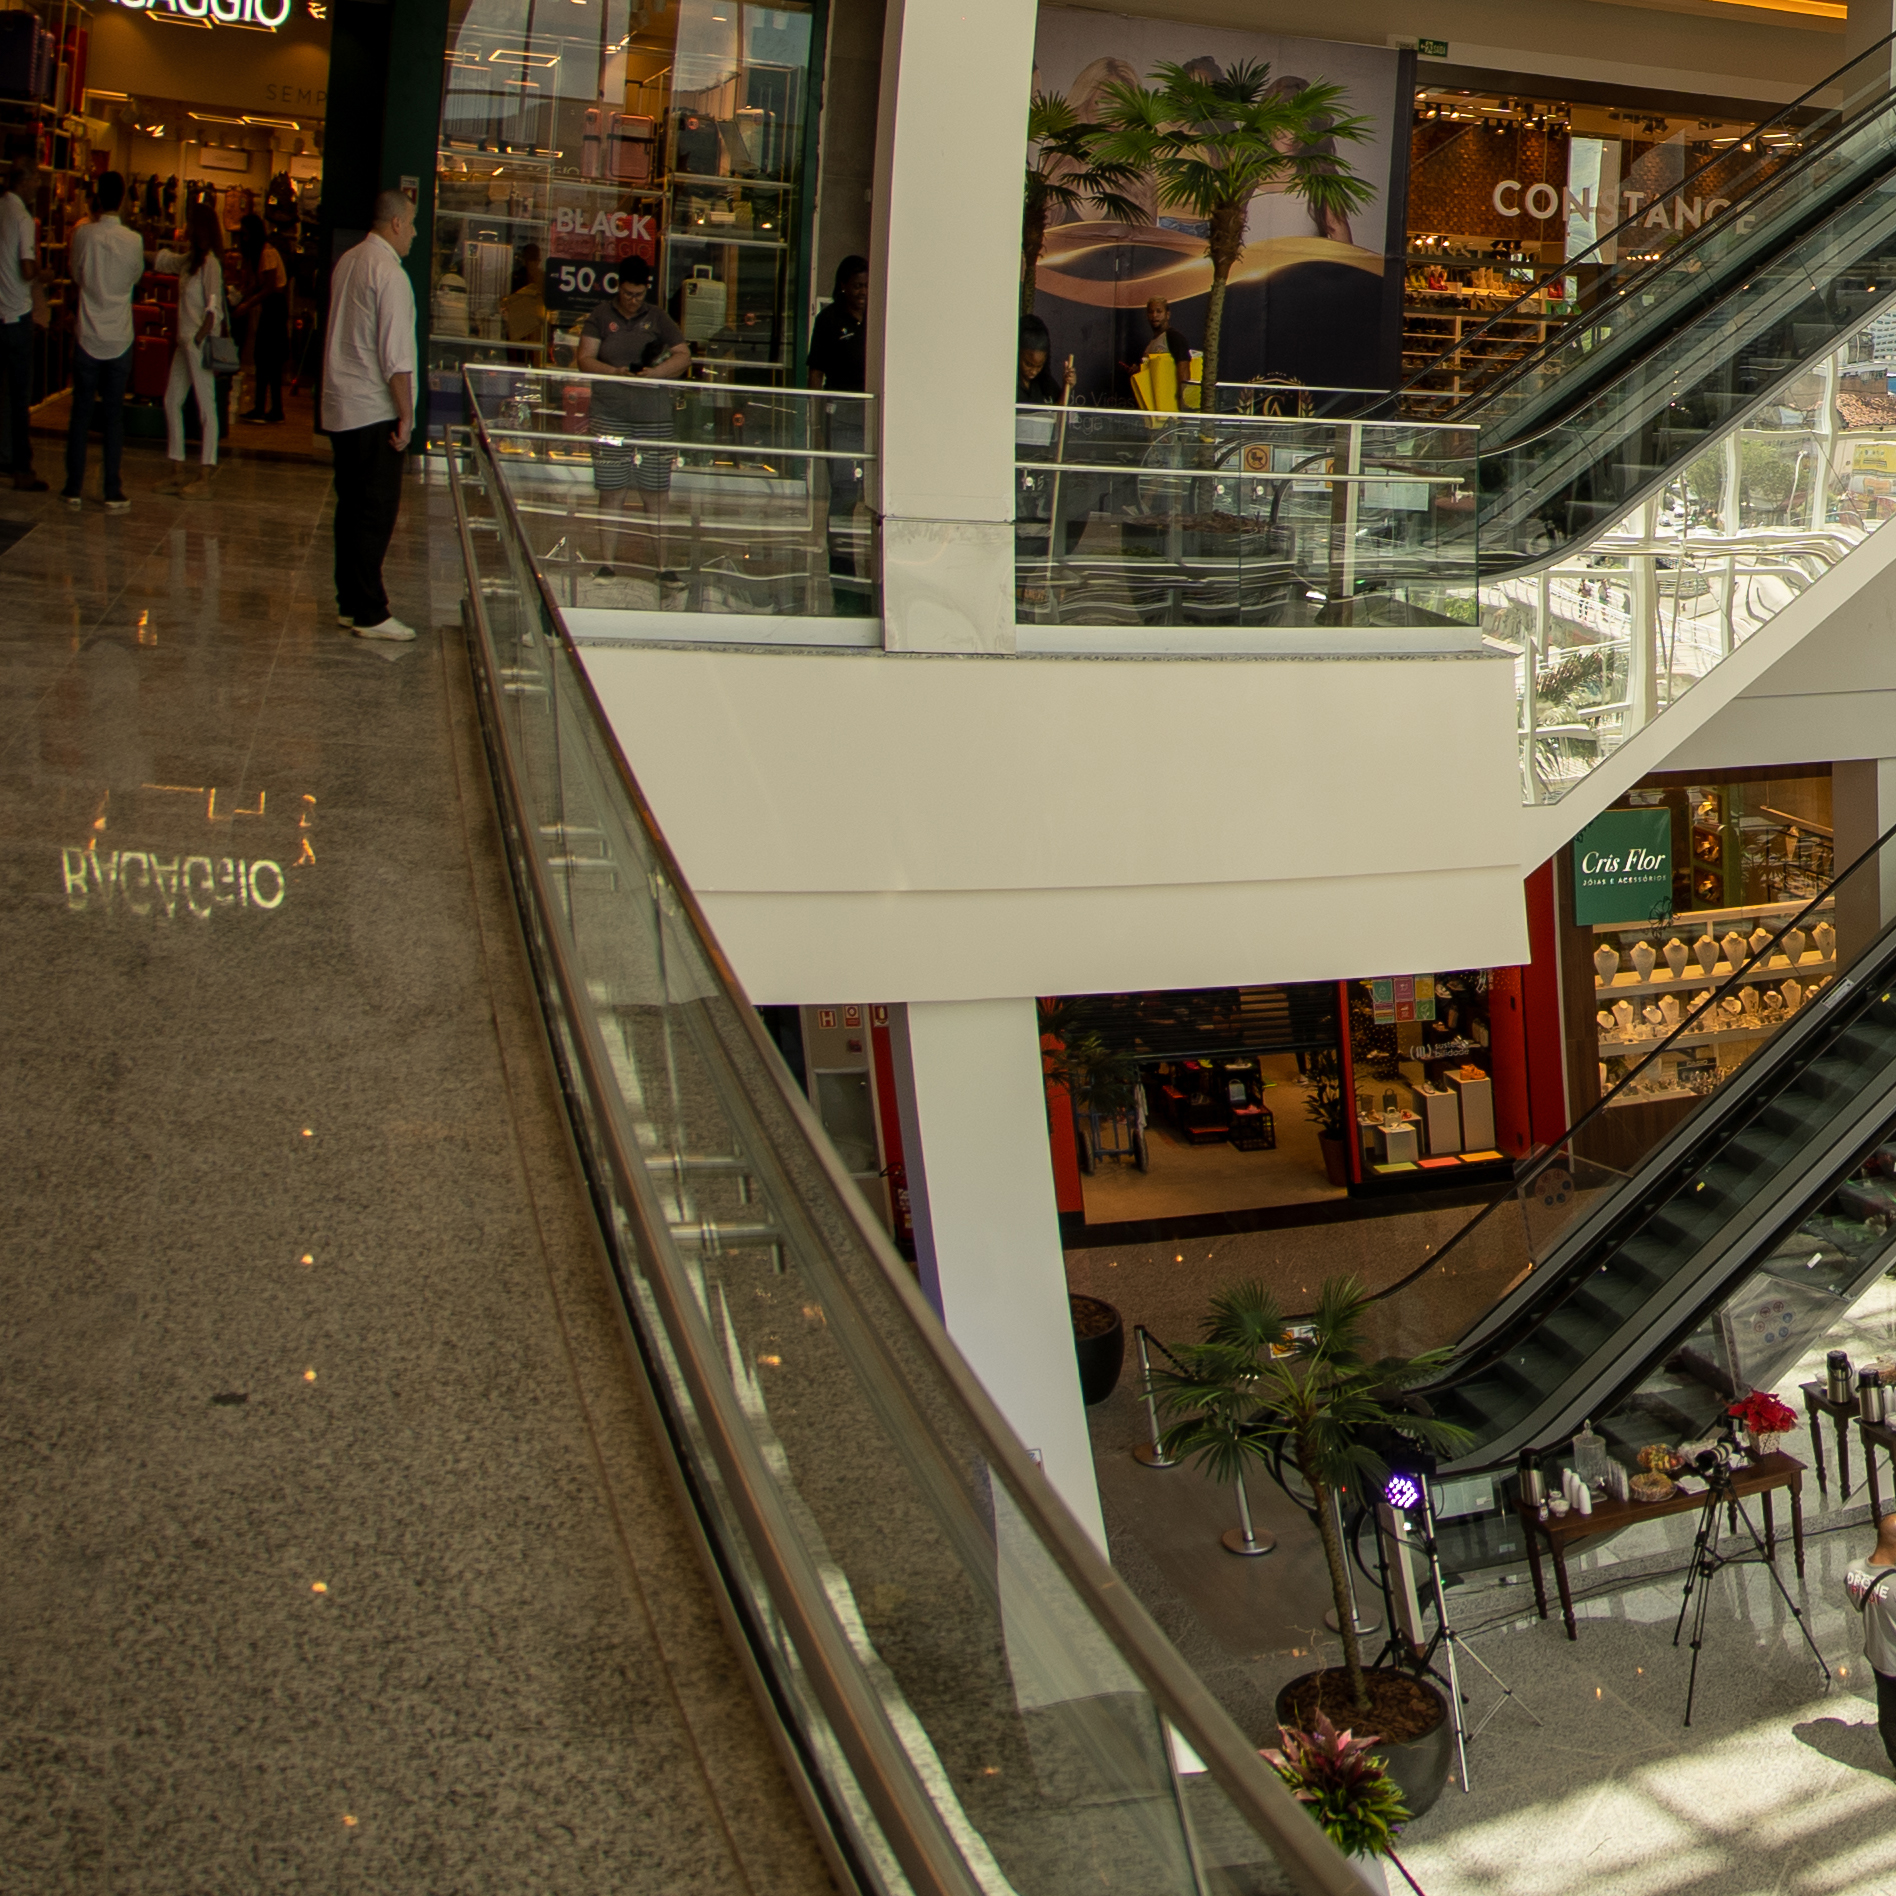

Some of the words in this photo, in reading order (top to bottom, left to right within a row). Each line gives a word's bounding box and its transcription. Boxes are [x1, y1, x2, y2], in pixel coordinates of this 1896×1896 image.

[556, 207, 652, 241] BLACK
[1582, 851, 1620, 874] Cris
[1622, 848, 1666, 872] Flor
